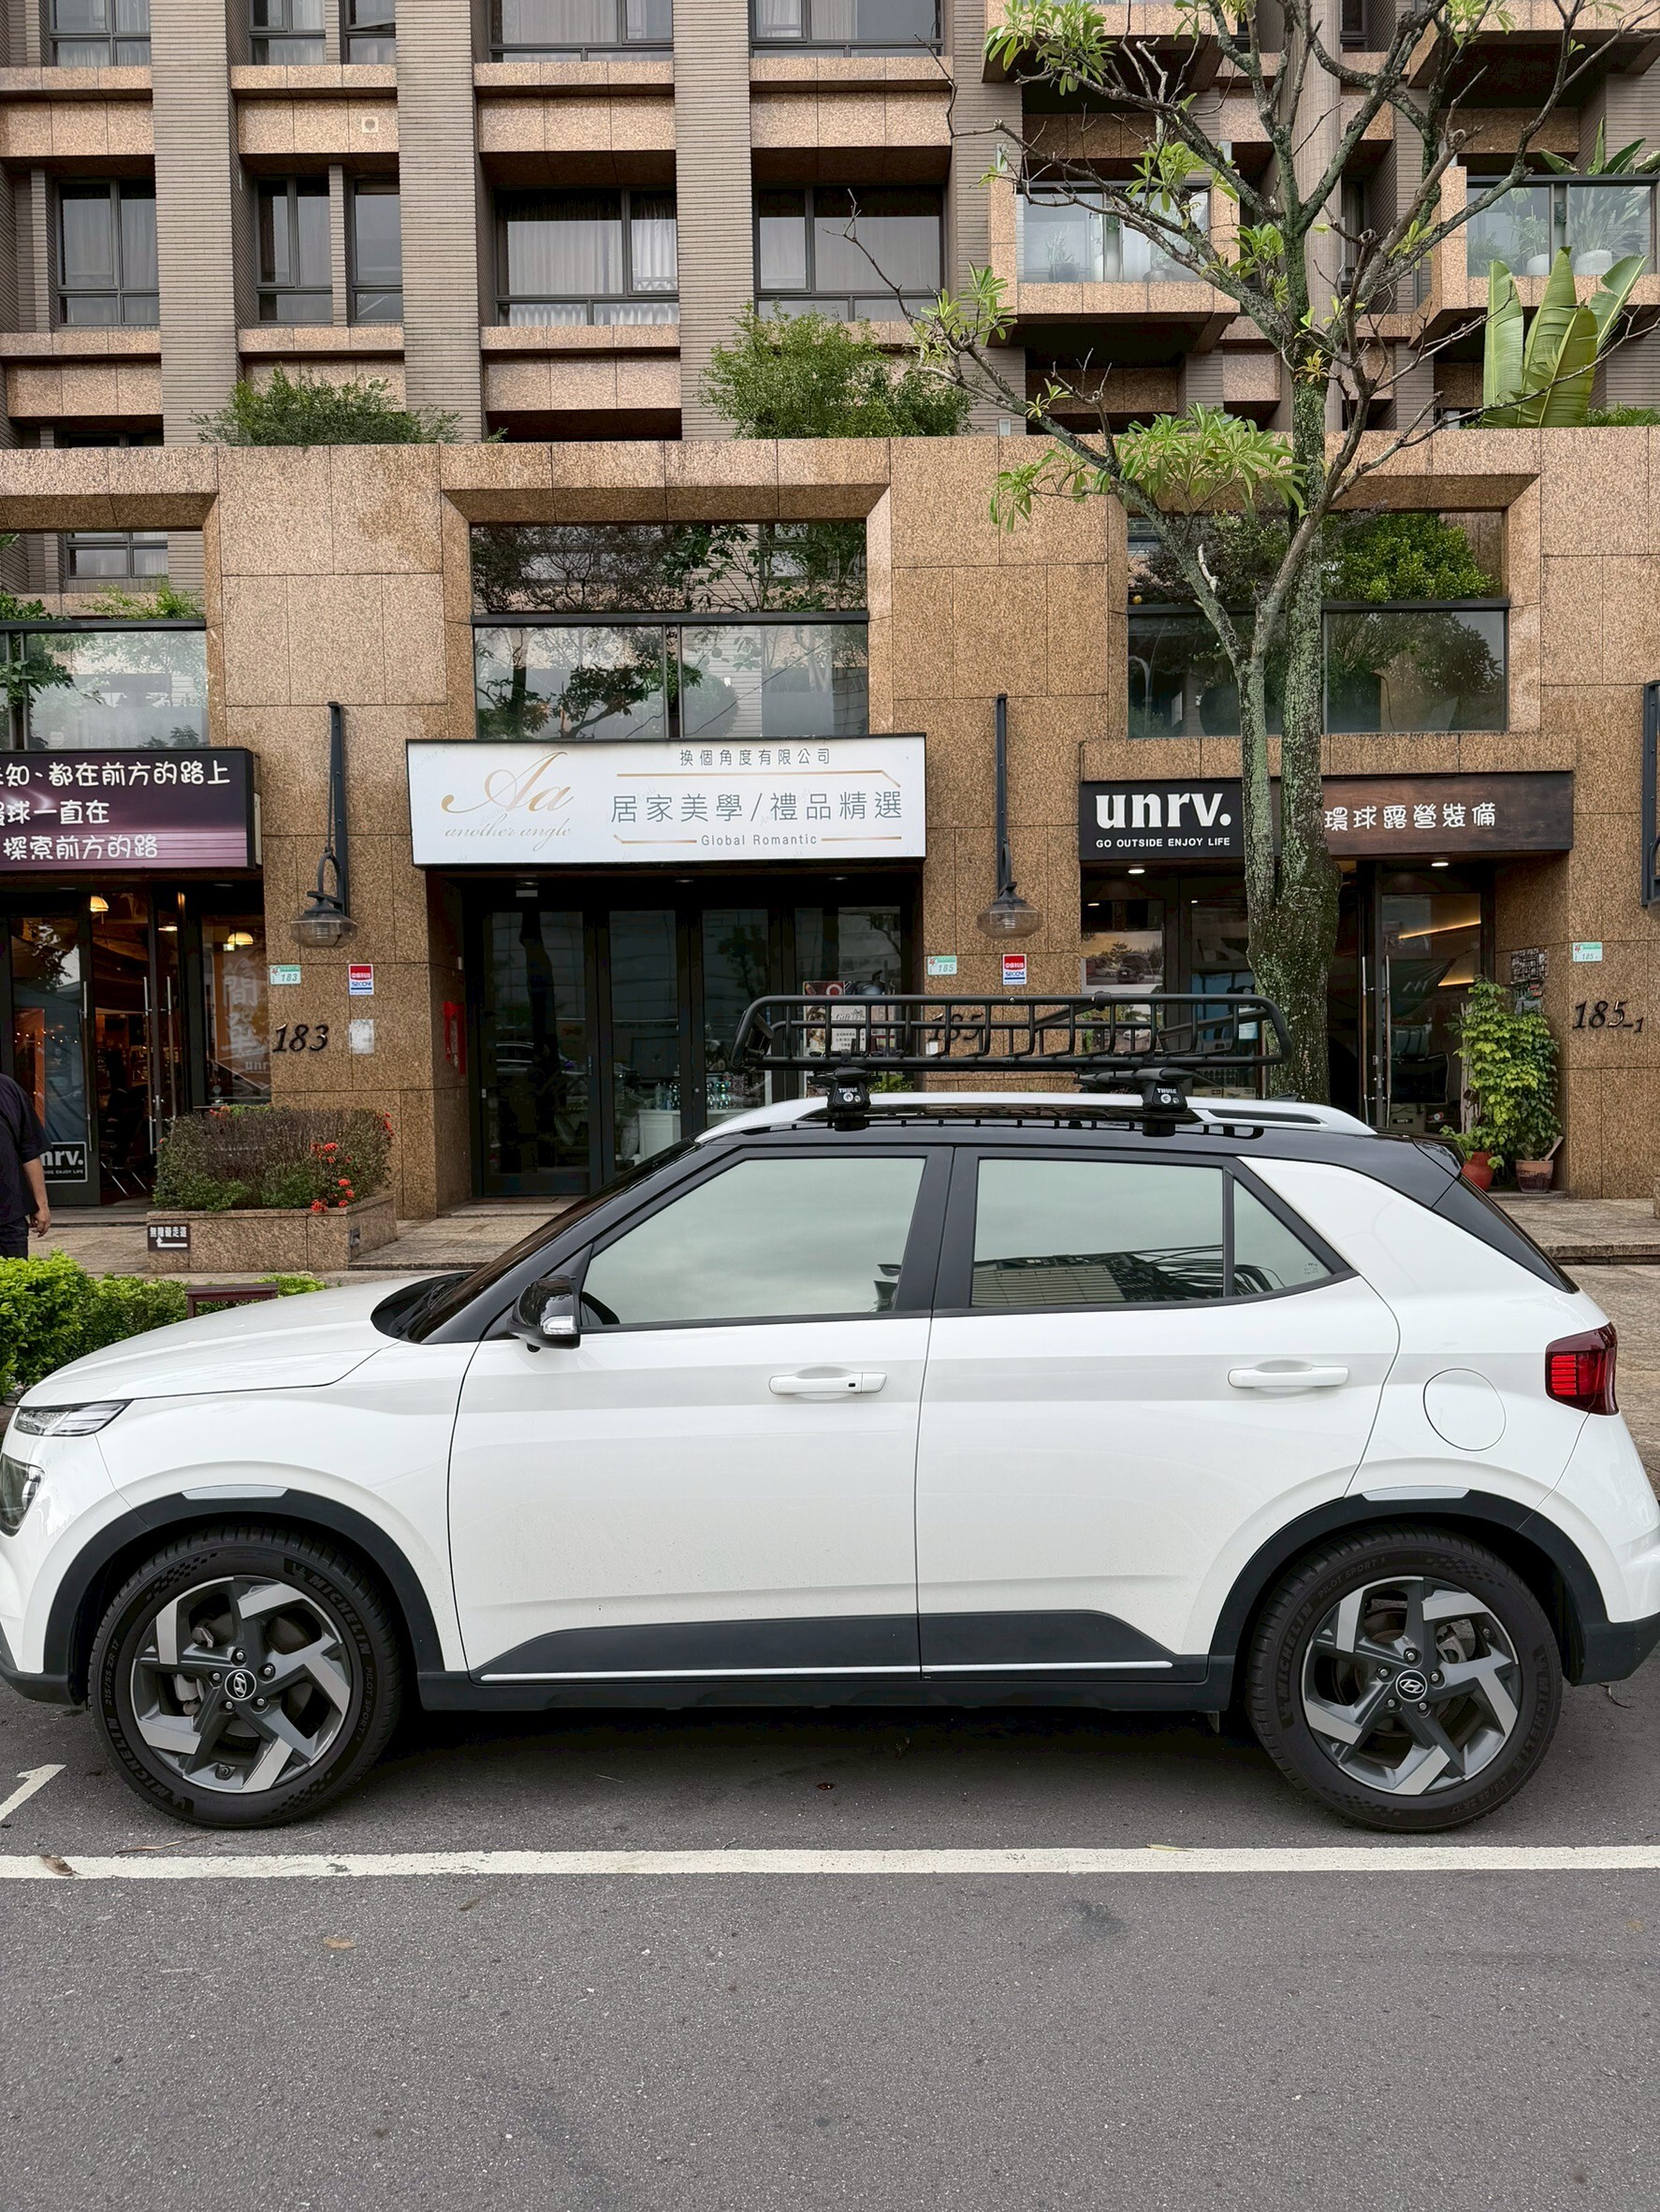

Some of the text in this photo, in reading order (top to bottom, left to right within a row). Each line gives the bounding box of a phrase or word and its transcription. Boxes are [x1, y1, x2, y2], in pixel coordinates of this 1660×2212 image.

[679, 748, 832, 766] 換個角度有限公司
[0, 760, 230, 788] 知、都在前方的路上
[441, 751, 575, 813] Aa
[0, 799, 110, 826] 球一直在
[610, 791, 903, 823] 居家美學/禮品精選
[1096, 793, 1232, 830] unrv.
[1323, 802, 1496, 832] 環球露營裝備
[444, 812, 574, 852] another angle
[701, 834, 818, 847] Global Romantic
[1096, 837, 1230, 849] GO OUTSIDE ENJOY LIFE
[3, 834, 158, 861] 探索前方的路
[281, 973, 299, 982] 183
[272, 1023, 329, 1053] 183
[245, 1060, 270, 1071] unr
[39, 1150, 84, 1166] nrv.
[1345, 1559, 1378, 1579] SPORT
[308, 1573, 372, 1654] MICHELIN
[1277, 1603, 1314, 1704] MICHELIN
[106, 1717, 172, 1797] MICHELIN
